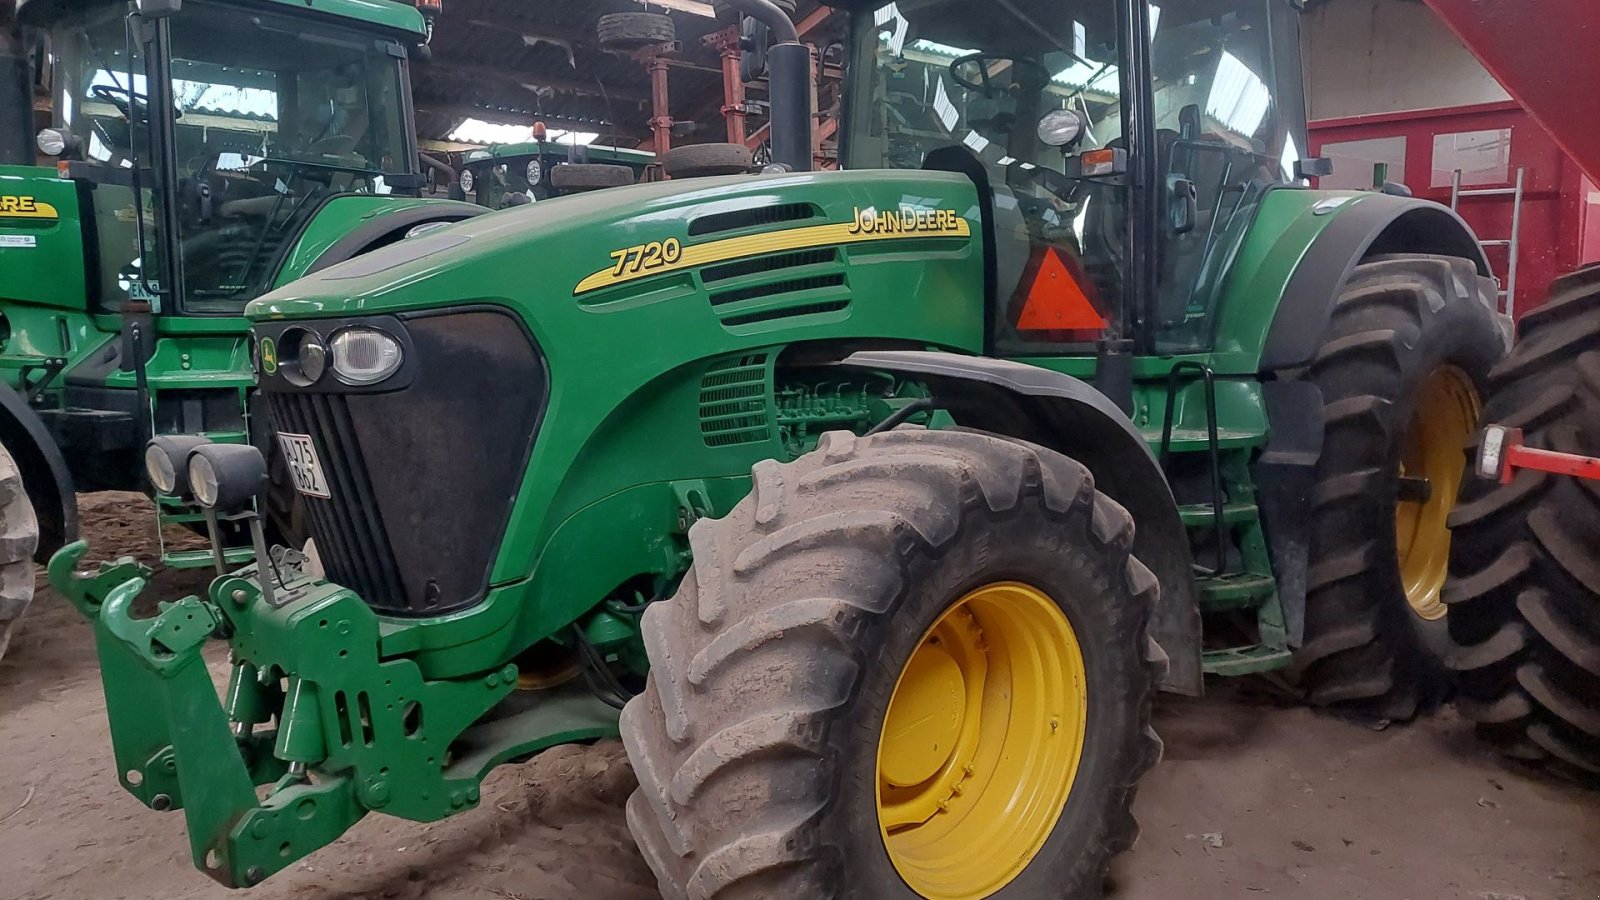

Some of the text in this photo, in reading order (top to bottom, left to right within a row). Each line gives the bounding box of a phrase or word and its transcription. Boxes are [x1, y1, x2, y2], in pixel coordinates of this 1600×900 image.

[0, 196, 36, 212] RE
[610, 236, 682, 277] 7720
[294, 465, 319, 491] 862
